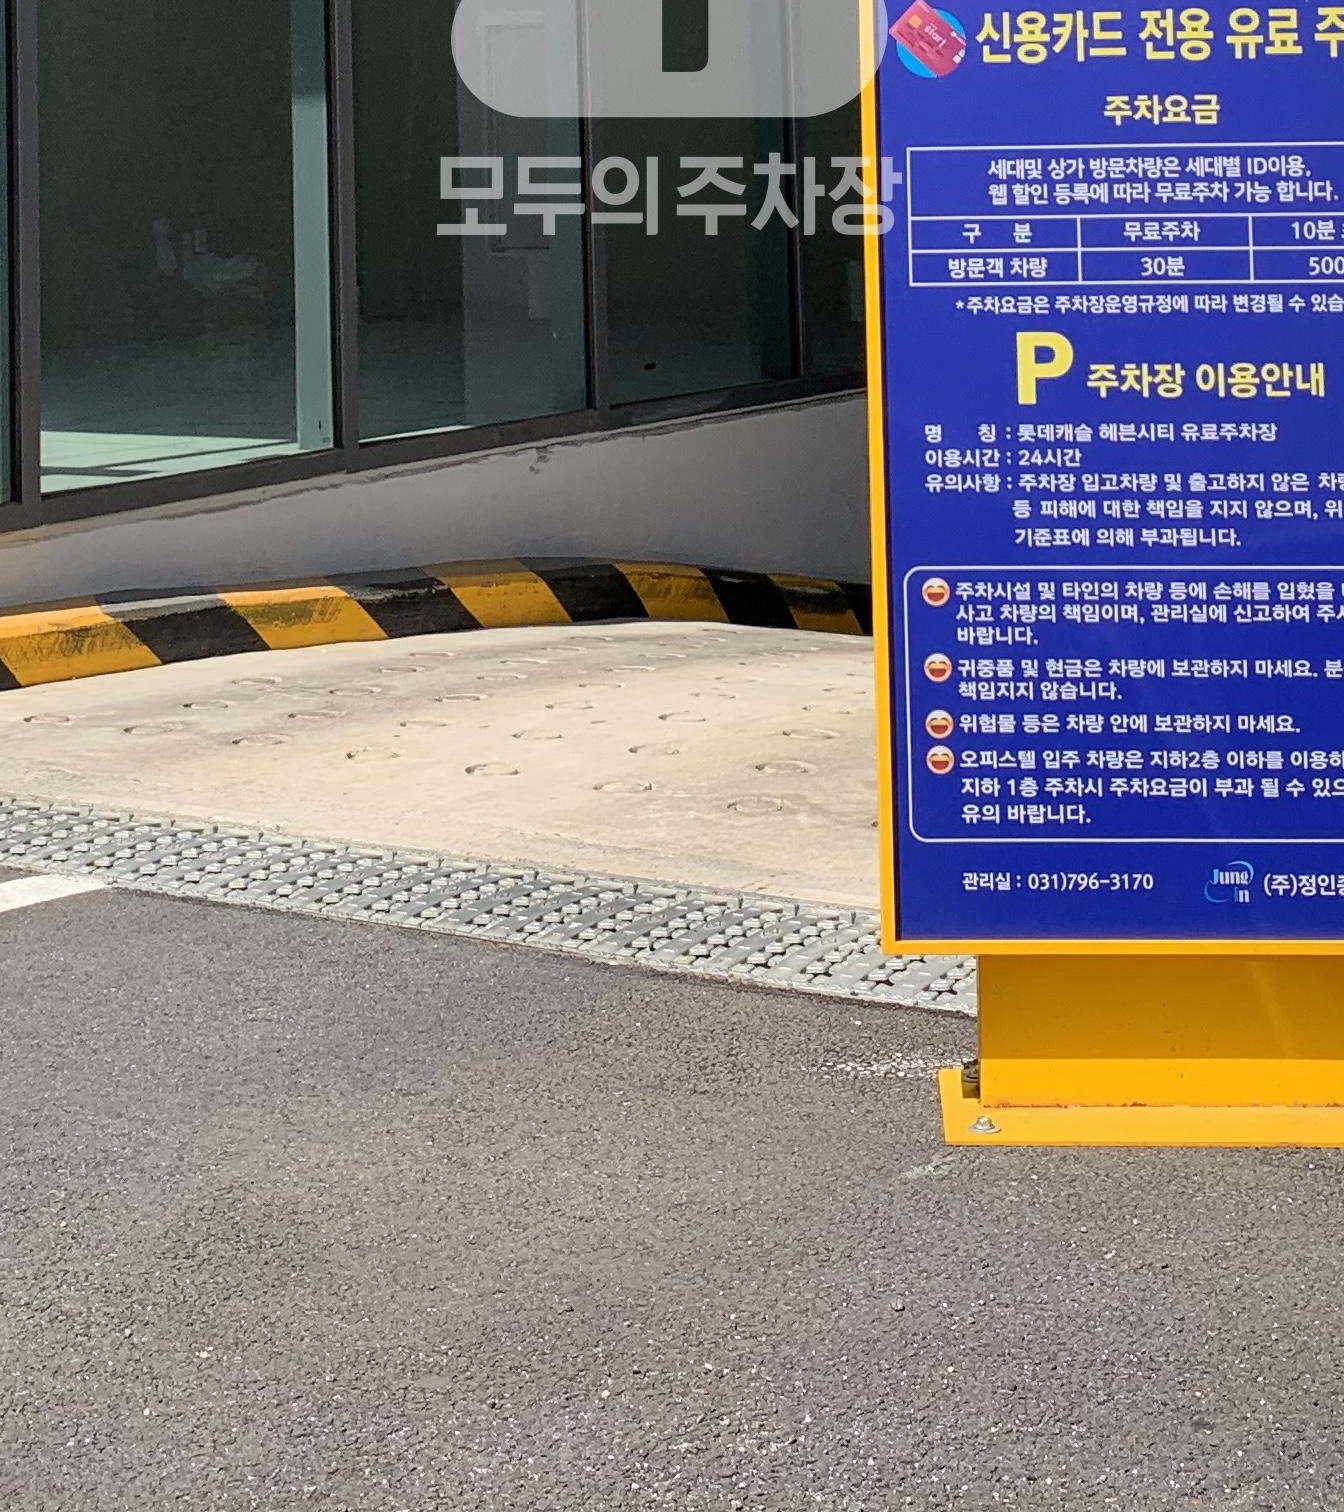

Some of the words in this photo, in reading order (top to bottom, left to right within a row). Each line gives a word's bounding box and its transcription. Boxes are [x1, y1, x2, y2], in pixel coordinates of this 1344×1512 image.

[975, 9, 1127, 65] 신용카드
[1138, 7, 1215, 62] 전용
[1225, 7, 1304, 60] 유료
[1103, 94, 1221, 126] 주차요금
[987, 157, 1043, 181] 세대및
[1047, 157, 1086, 180] 상가
[1089, 156, 1182, 180] 방문차량은
[1184, 155, 1242, 178] 세대별
[1246, 154, 1312, 182] ID이용,
[987, 183, 1008, 206] 웹
[1011, 182, 1049, 206] 할인
[1052, 182, 1109, 206] 등록에
[1112, 181, 1152, 204] 따라
[1154, 180, 1231, 204] 무료주차
[1233, 180, 1273, 203] 가능
[1275, 179, 1339, 203] 합니다.
[1123, 220, 1201, 243] 무료주차
[1291, 219, 1336, 241] 10분
[948, 257, 1004, 280] 방문객
[1009, 257, 1048, 279] 차량
[1140, 256, 1186, 277] 30분
[1054, 294, 1189, 315] 주차장운영규정에
[1194, 293, 1229, 314] 따라
[1232, 293, 1284, 314] 변경될
[1287, 293, 1307, 313] 수
[1015, 331, 1074, 406] P
[1086, 362, 1186, 399] 주차장
[1195, 362, 1325, 399] 이용안내
[1016, 423, 1094, 443] 롯데캐슬
[1098, 422, 1175, 443] 헤븐시티
[1180, 422, 1278, 442] 유료주차장
[924, 448, 1001, 468] 이용시간
[1017, 447, 1083, 468] 24시간
[924, 473, 1002, 493] 유의사항
[1017, 473, 1077, 493] 주차장
[1081, 472, 1159, 493] 입고차량
[1163, 472, 1182, 492] 및
[1187, 472, 1265, 493] 출고하지
[1270, 472, 1310, 493] 않은
[1011, 499, 1032, 519] 등
[1039, 499, 1097, 519] 피해에
[1102, 499, 1142, 519] 대한
[1145, 499, 1204, 519] 책임을
[1209, 499, 1248, 519] 지지
[1254, 499, 1319, 521] 않으며,
[1324, 499, 1343, 519] 위
[1014, 527, 1090, 548] 기준표에
[1095, 527, 1135, 548] 의해
[1139, 527, 1242, 547] 부과됩니다.
[954, 581, 1032, 602] 주차시설
[1037, 581, 1056, 601] 및
[1062, 581, 1119, 601] 타인의
[1124, 581, 1164, 601] 차량
[1168, 581, 1207, 601] 등에
[1212, 581, 1272, 601] 손해를
[1276, 581, 1336, 601] 입혔을
[955, 604, 995, 624] 사고
[999, 604, 1057, 624] 차량의
[1062, 604, 1145, 625] 책임이며,
[1150, 604, 1227, 624] 관리실에
[1233, 604, 1310, 623] 신고하여
[956, 625, 1039, 646] 바랍니다.
[957, 658, 1015, 679] 귀중품
[1020, 658, 1039, 678] 및
[1045, 658, 1103, 678] 현금은
[1108, 658, 1166, 679] 차량에
[1170, 658, 1248, 679] 보관하지
[1254, 659, 1318, 679] 마세요.
[958, 680, 1034, 701] 책임지지
[1039, 680, 1123, 701] 않습니다.
[958, 713, 1017, 734] 위험물
[1021, 713, 1061, 734] 등은
[1065, 713, 1105, 734] 차량
[1109, 714, 1148, 734] 안에
[1153, 714, 1231, 734] 보관하지
[1237, 714, 1301, 734] 마세요.
[959, 749, 1037, 770] 오피스텔
[1042, 749, 1081, 770] 입주
[1086, 749, 1145, 770] 차량은
[1149, 749, 1221, 770] 지하2층
[1226, 750, 1285, 770] 이하를
[960, 777, 1002, 798] 지하
[1006, 776, 1039, 798] 1층
[1043, 777, 1103, 798] 주차시
[1109, 777, 1208, 798] 주차요금이
[1213, 777, 1255, 798] 부과
[1259, 777, 1280, 798] 될
[1285, 778, 1306, 798] 수
[961, 803, 1001, 825] 유의
[1007, 803, 1092, 825] 바랍니다.
[962, 871, 1011, 892] 관리실
[1027, 871, 1154, 892] 031)796-3170
